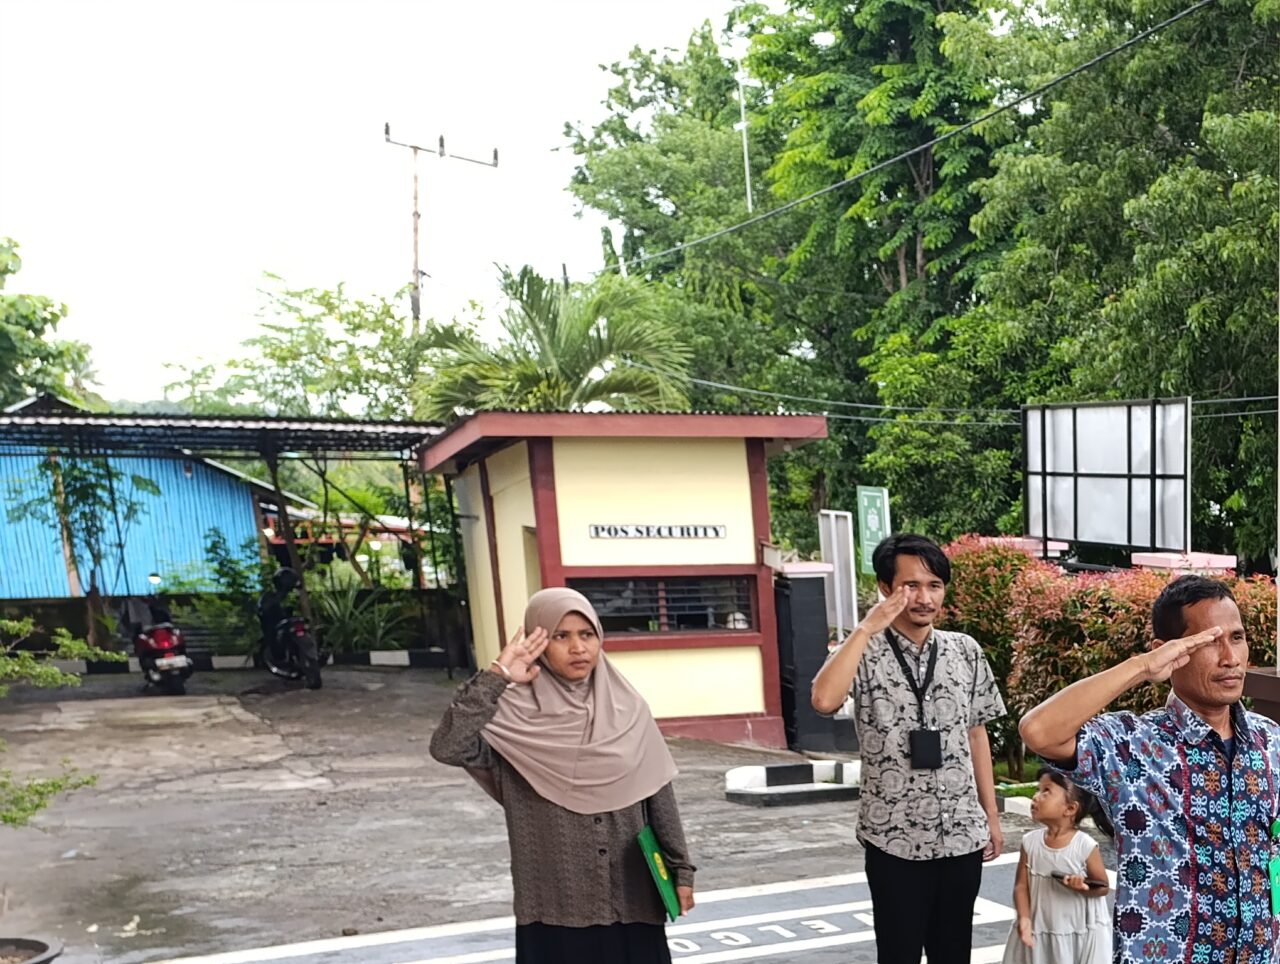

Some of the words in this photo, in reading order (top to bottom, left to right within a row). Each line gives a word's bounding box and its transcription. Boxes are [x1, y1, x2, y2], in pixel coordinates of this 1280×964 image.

[594, 525, 629, 537] POS
[635, 525, 721, 538] SECURITY
[667, 911, 874, 952] ELCO
